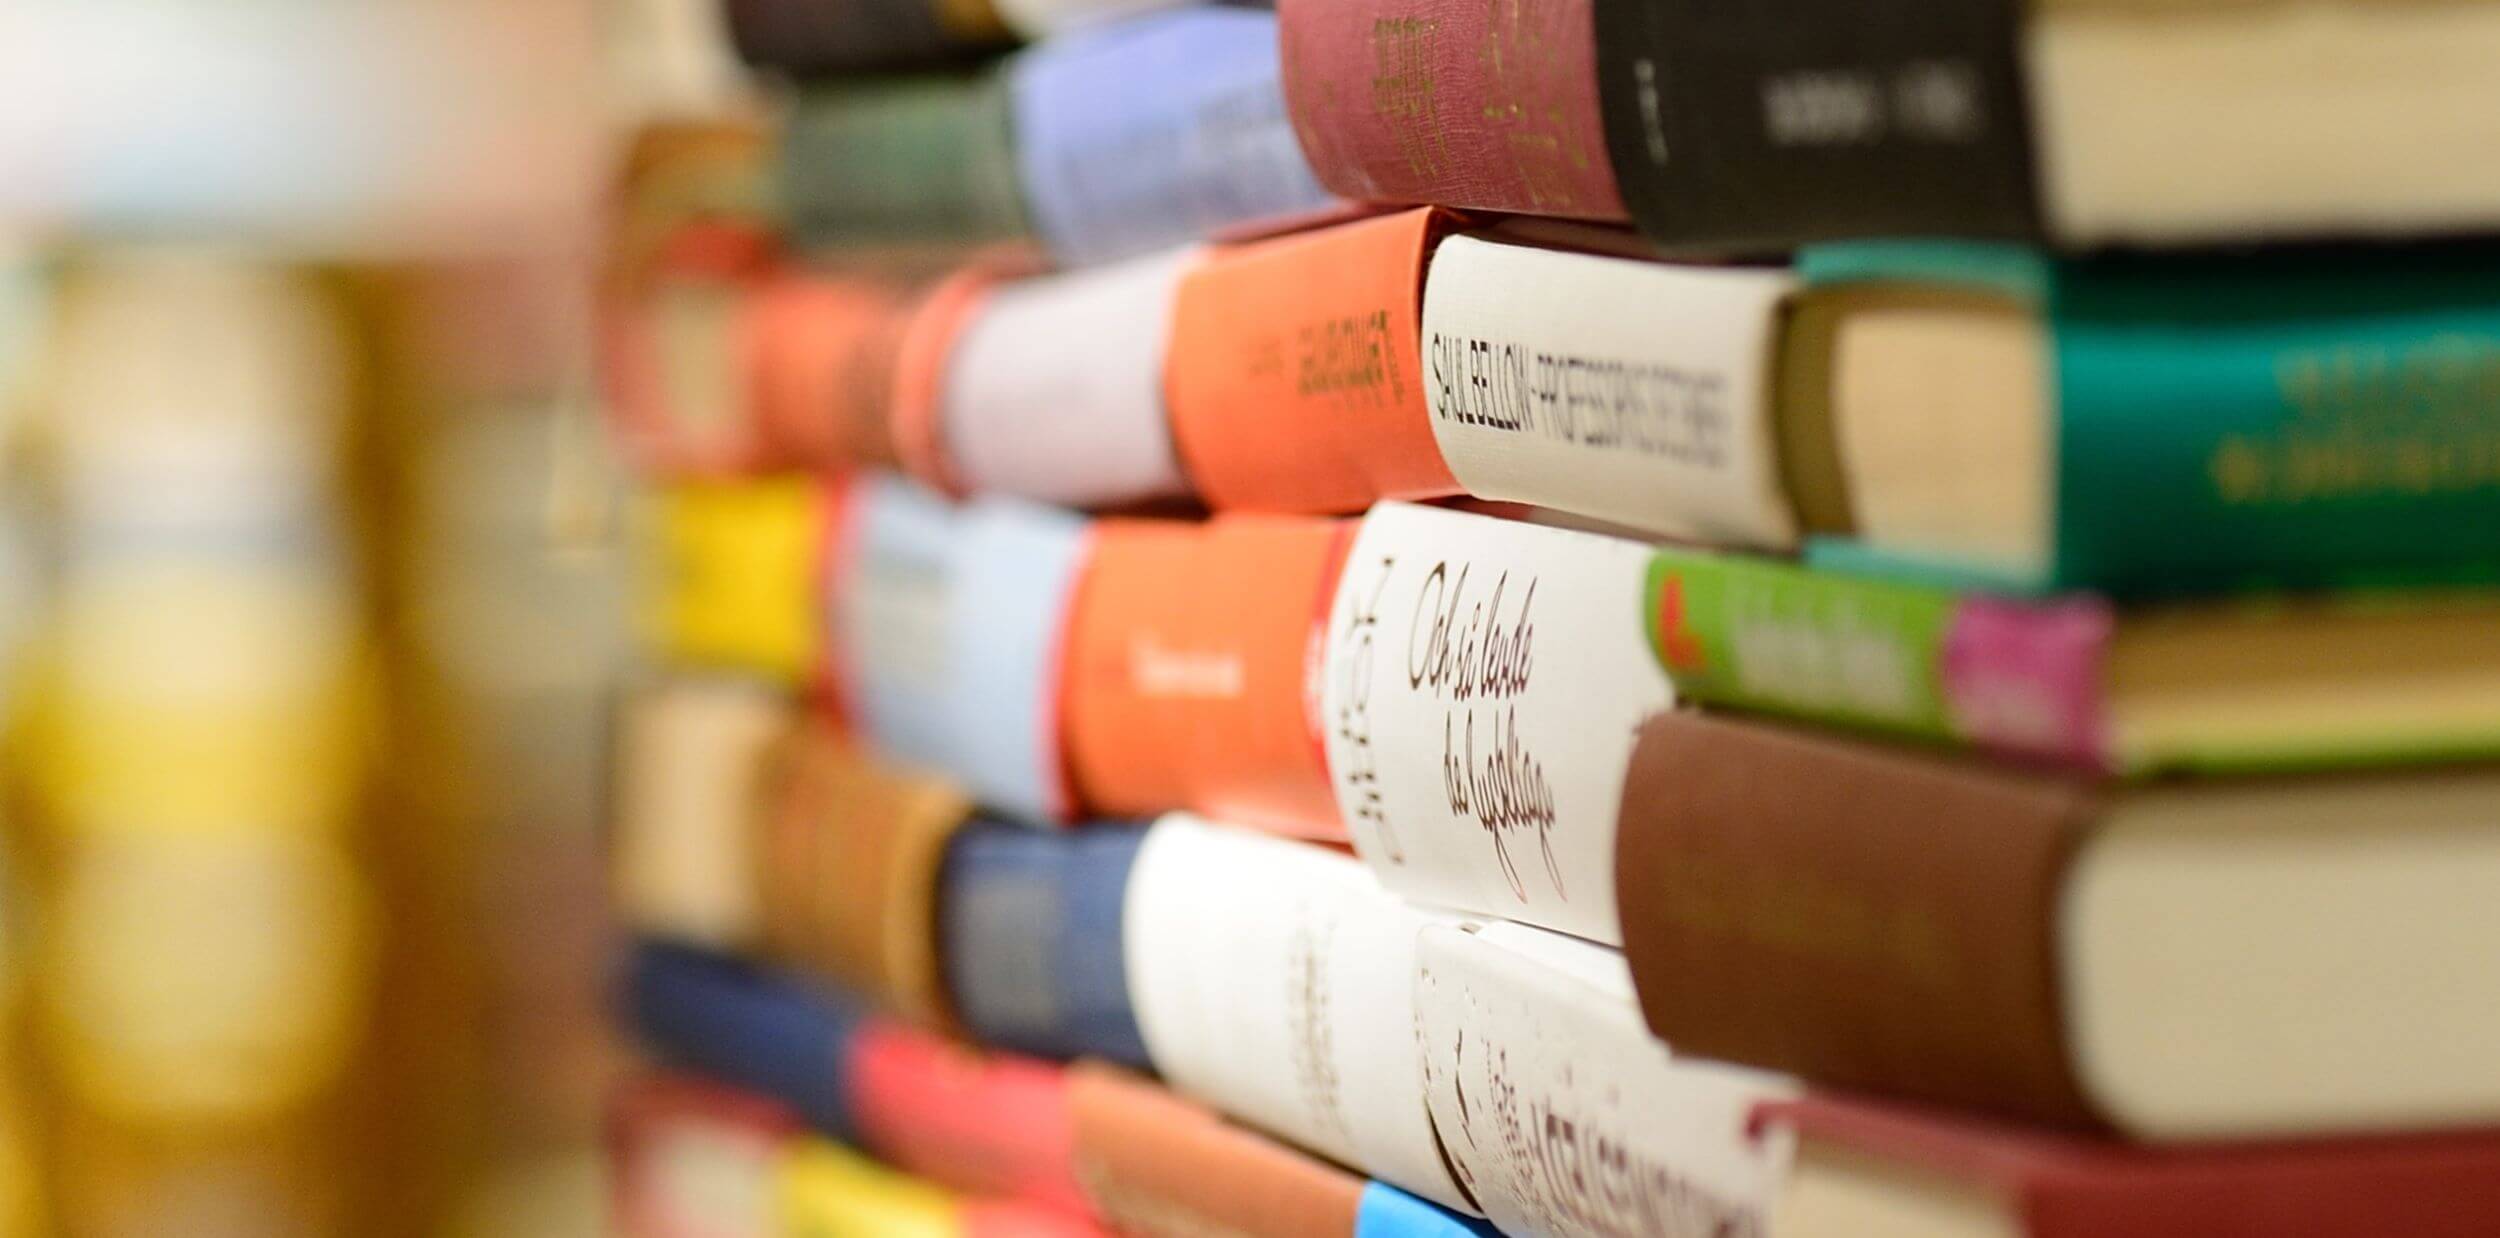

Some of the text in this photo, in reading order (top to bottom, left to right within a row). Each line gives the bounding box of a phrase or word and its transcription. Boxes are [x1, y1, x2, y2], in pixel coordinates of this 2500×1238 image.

[1432, 332, 1476, 424] SAUL
[1469, 339, 1535, 432] BELLOW
[1408, 560, 1470, 698] Och
[1444, 710, 1469, 817] de
